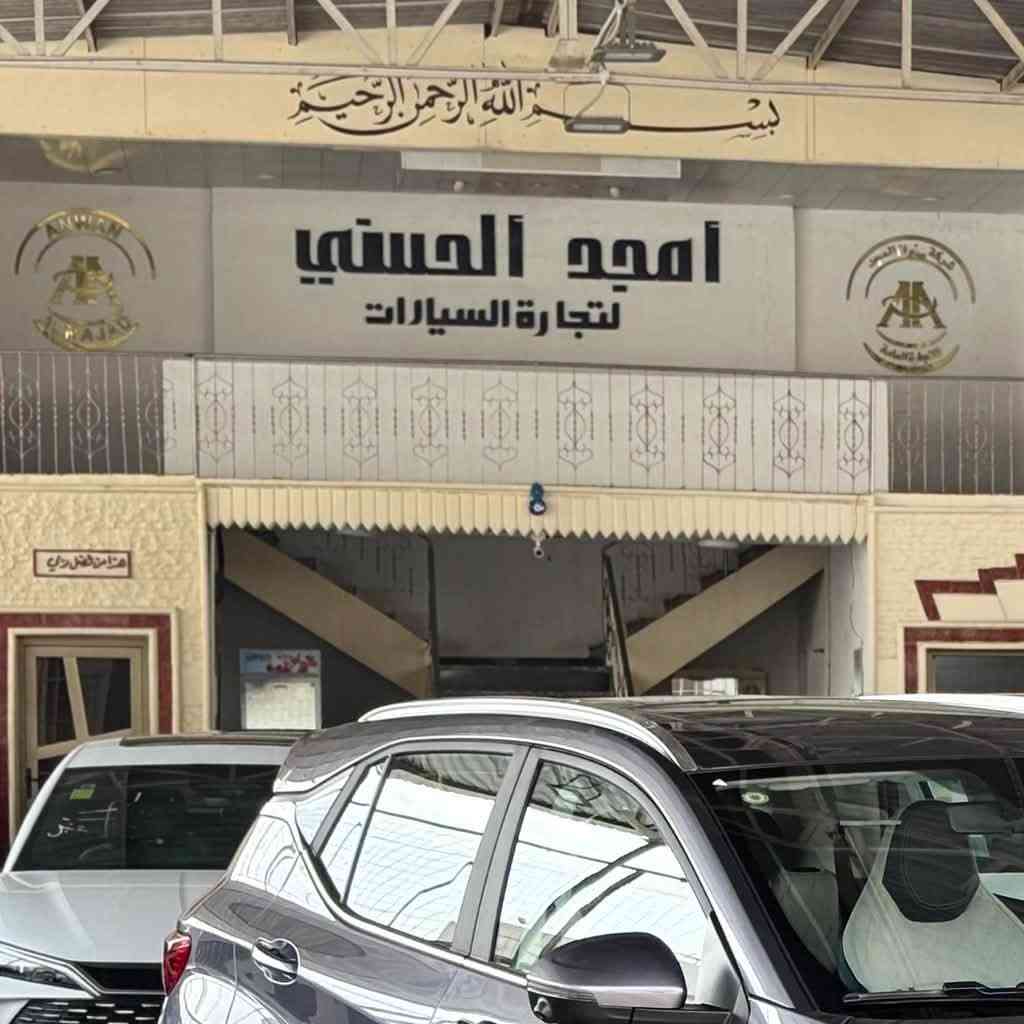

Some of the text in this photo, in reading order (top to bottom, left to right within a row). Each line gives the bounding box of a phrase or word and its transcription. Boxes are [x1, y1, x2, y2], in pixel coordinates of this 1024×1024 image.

[296, 214, 524, 285] الحسني
[365, 297, 620, 338] لتجارة السيارات
